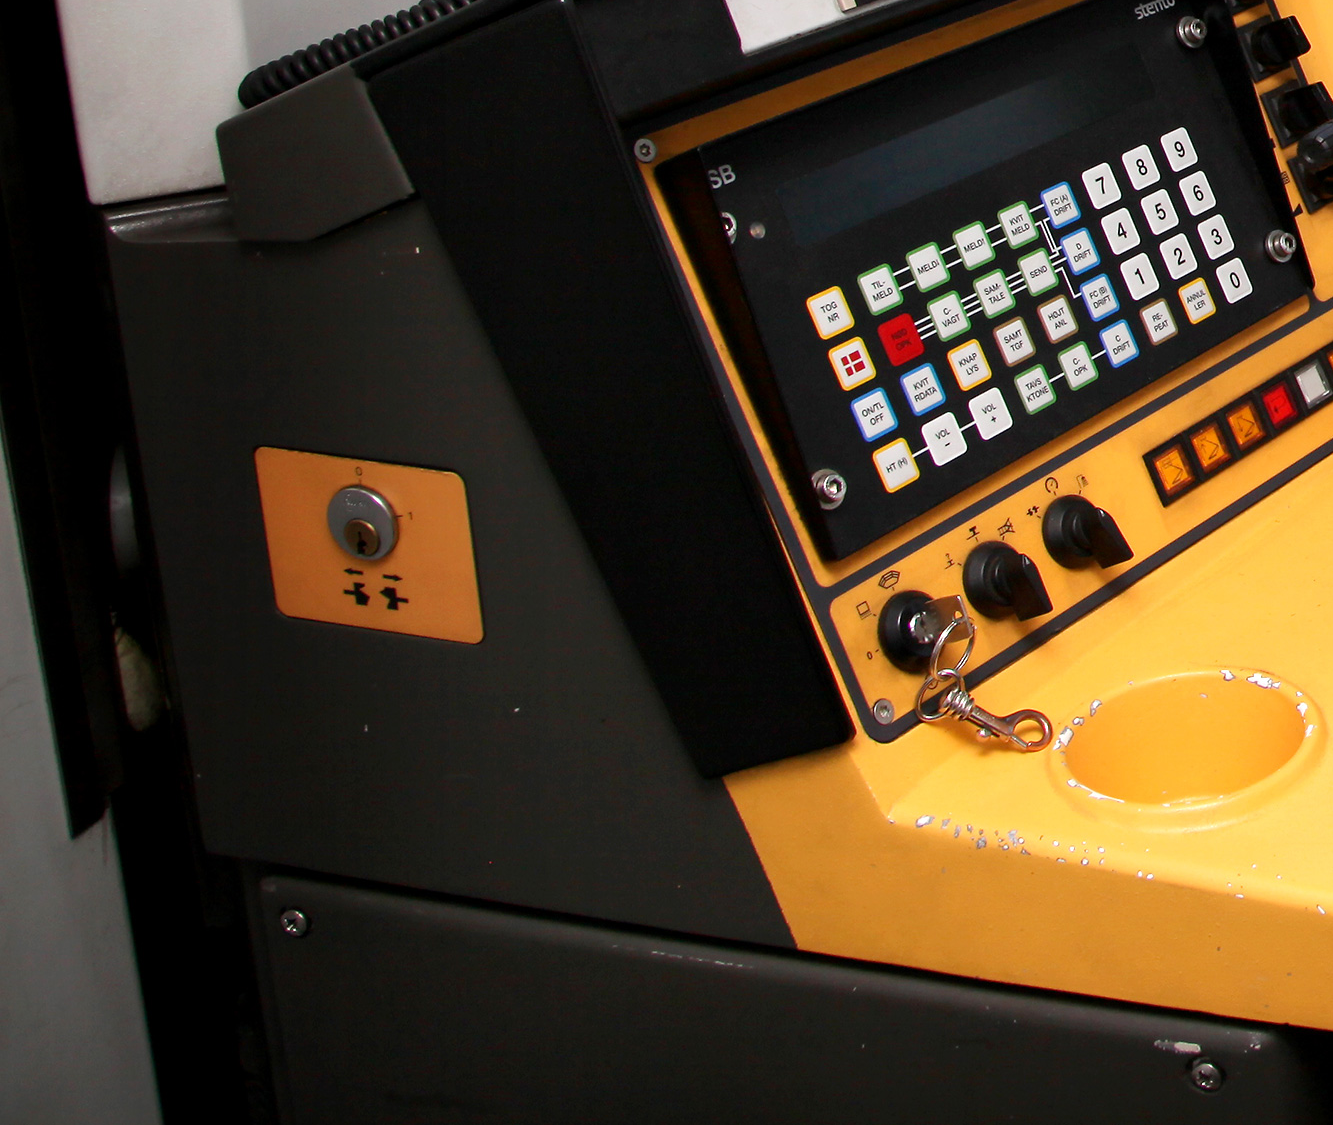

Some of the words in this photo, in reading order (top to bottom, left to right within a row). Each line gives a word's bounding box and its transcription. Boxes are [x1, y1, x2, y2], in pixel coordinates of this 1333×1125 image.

[1174, 140, 1186, 158] 9
[1135, 158, 1148, 176] 8
[1095, 176, 1106, 195] 7
[1192, 184, 1204, 201] 6
[1050, 197, 1060, 207] FC
[1060, 193, 1069, 204] (A)
[1054, 203, 1073, 217] DRIFT
[1154, 203, 1166, 221] 5
[1009, 214, 1025, 226] KVIT
[1011, 223, 1031, 237] MELD
[1117, 221, 1128, 239] 4
[1210, 228, 1223, 245] 3
[1076, 243, 1082, 251] D
[1073, 249, 1092, 263] DRIFT
[1173, 247, 1186, 266] 2
[1030, 265, 1048, 279] SEND
[1134, 267, 1145, 285] 1
[871, 280, 886, 290] TIL-
[1229, 271, 1241, 289] 0
[872, 287, 894, 302] MELD
[983, 283, 1002, 296] SAM-
[1089, 289, 1098, 299] FC
[1186, 289, 1207, 303] ANNUL
[988, 292, 1006, 305] TALE
[1093, 295, 1112, 309] DRIFT
[1194, 300, 1206, 311] LER
[820, 301, 838, 313] TOG
[942, 307, 952, 315] C-
[827, 313, 840, 324] NR
[942, 313, 961, 328] VAGT
[1054, 318, 1068, 330] ANL
[1152, 313, 1164, 322] RE-
[1154, 320, 1169, 333] PEAT
[1003, 329, 1022, 344] SAMT
[1115, 335, 1122, 343] C
[1010, 341, 1025, 352] TGF
[1112, 341, 1131, 355] DRIFT
[958, 352, 978, 367] KNAP
[1072, 357, 1082, 366] C-
[966, 365, 980, 377] LYS
[1073, 364, 1089, 377] OPK
[912, 377, 930, 391] KVIT
[1025, 377, 1043, 390] TAVS
[914, 386, 938, 403] RDATA
[1026, 386, 1050, 403] KTONE
[861, 401, 885, 417] ON/TL
[981, 403, 997, 415] VOL
[870, 413, 884, 425] OFF
[935, 428, 951, 440] VOL
[355, 466, 363, 476] 0
[886, 462, 896, 473] HT
[897, 456, 909, 470] (H)
